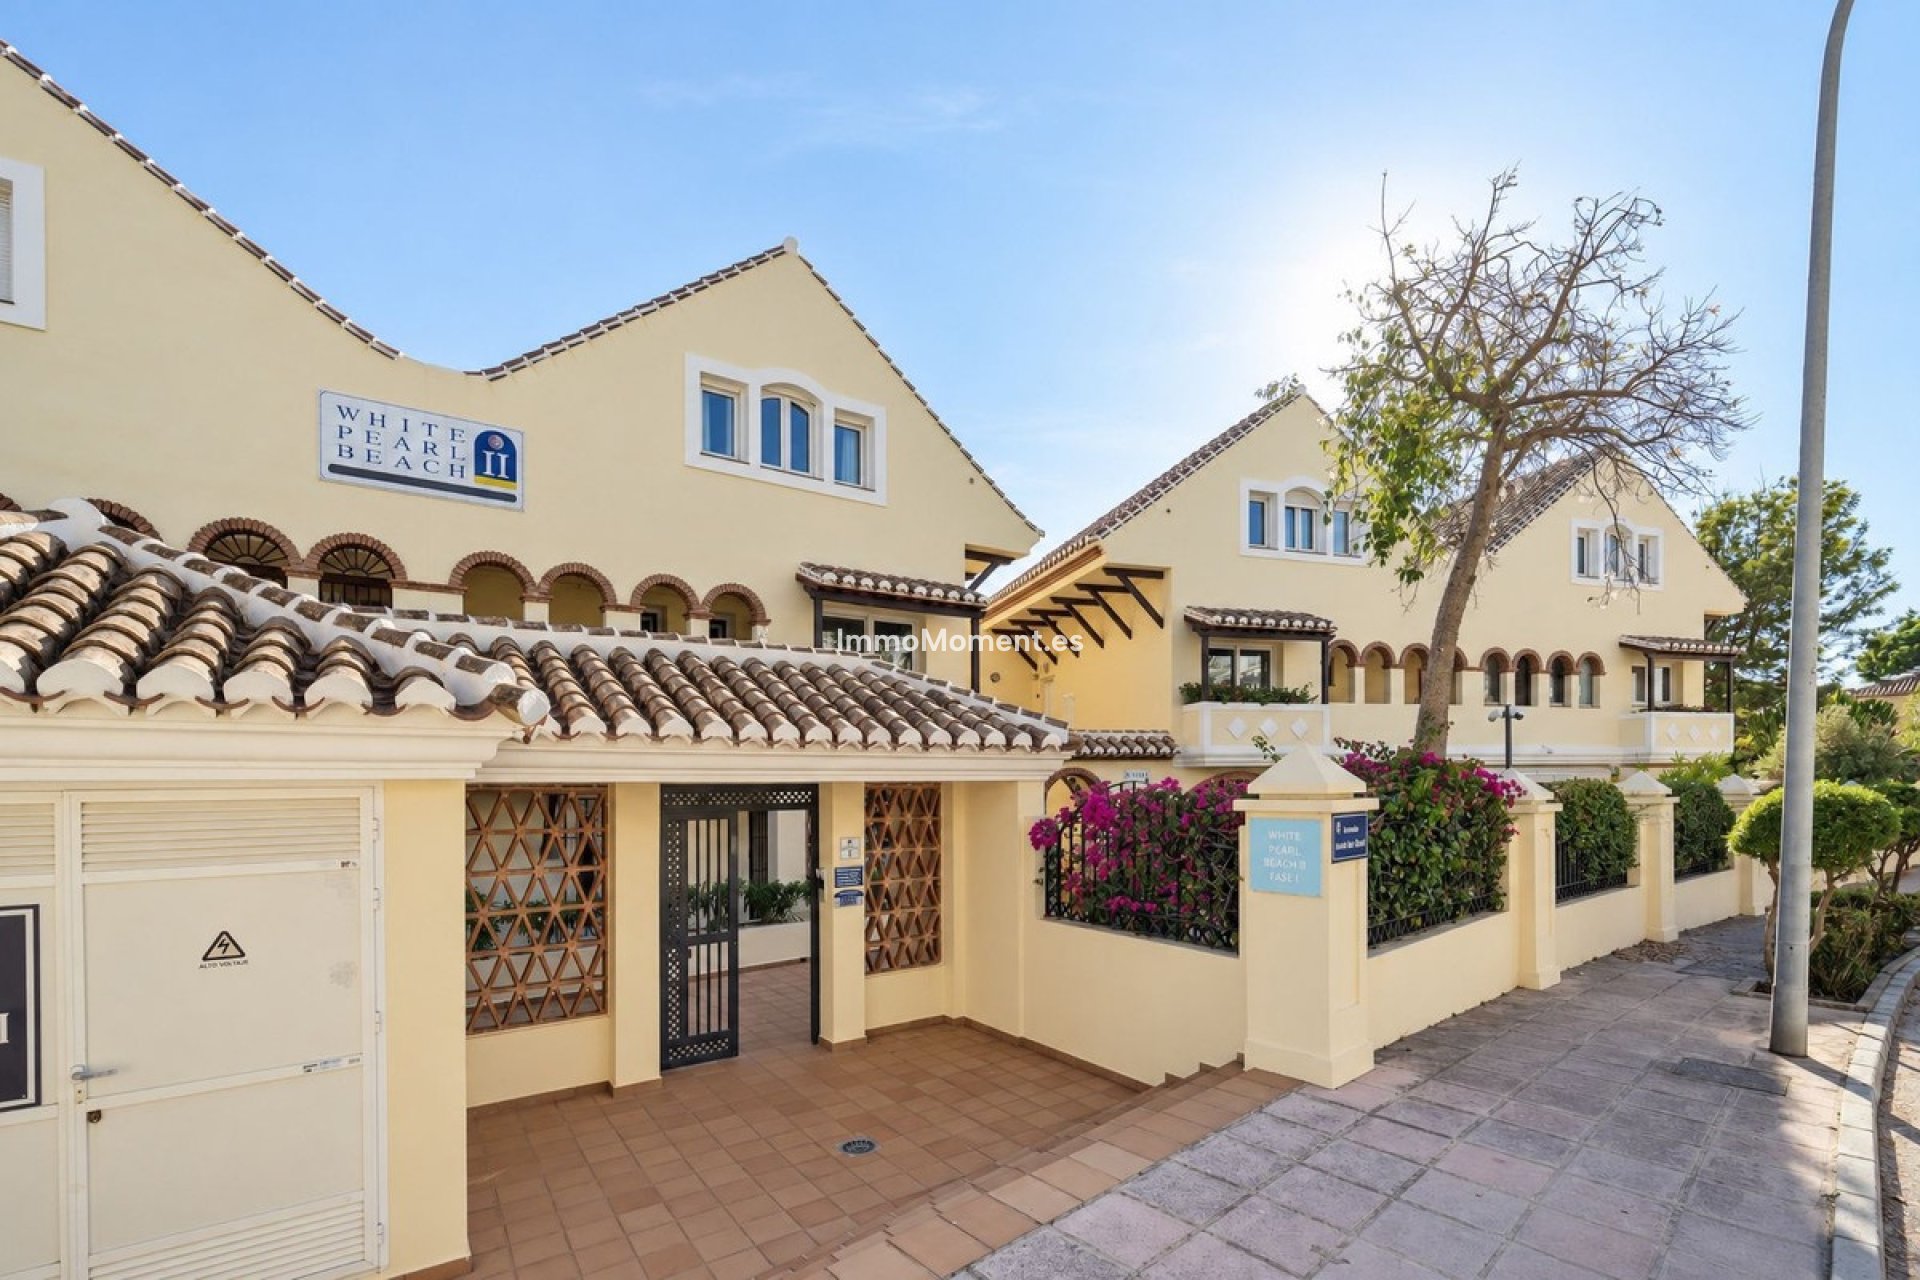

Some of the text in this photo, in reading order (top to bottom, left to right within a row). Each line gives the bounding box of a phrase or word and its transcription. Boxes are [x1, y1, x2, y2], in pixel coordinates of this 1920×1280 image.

[336, 404, 466, 444] WHITE
[338, 424, 466, 462] PEARL
[338, 444, 466, 479] BEACH
[482, 450, 510, 479] II
[1267, 830, 1302, 841] WHITE
[1263, 857, 1297, 870] BEACH
